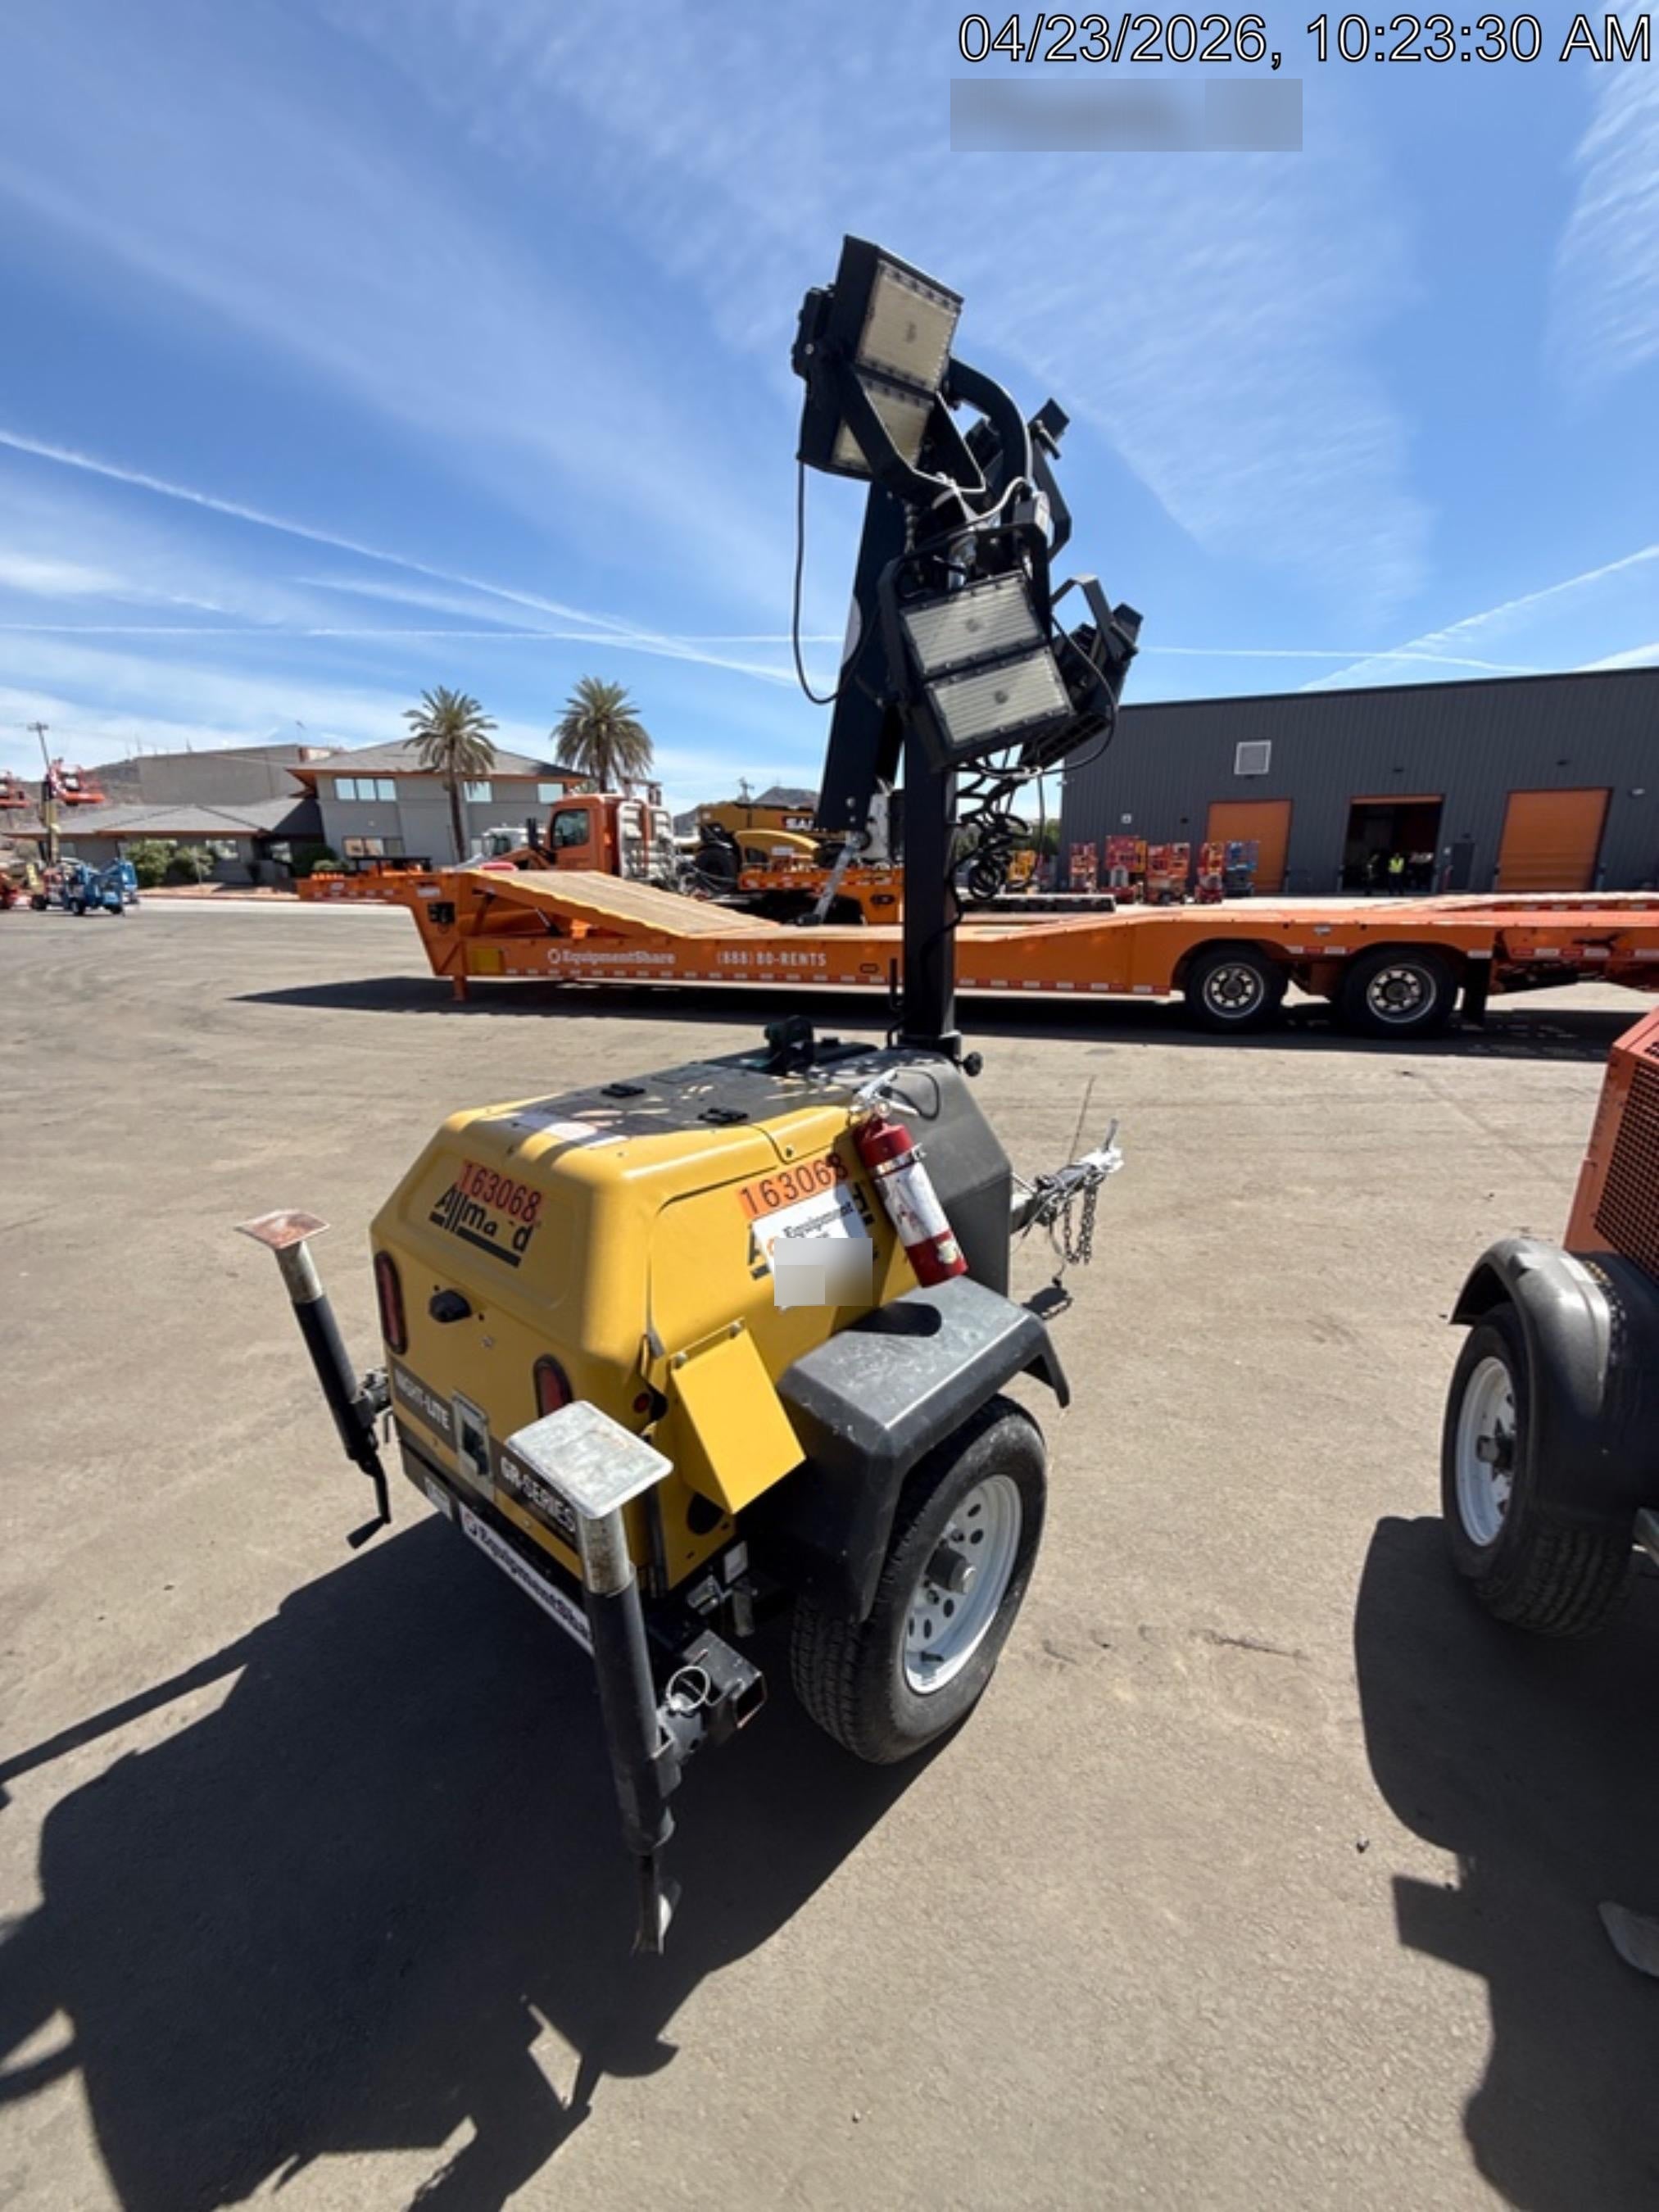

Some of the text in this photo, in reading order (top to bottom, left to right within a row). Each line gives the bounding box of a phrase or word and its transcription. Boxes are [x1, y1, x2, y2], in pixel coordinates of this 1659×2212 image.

[562, 949, 676, 965] EquipmentShare
[460, 1162, 542, 1222] 163068
[741, 1152, 850, 1215] 163068
[434, 1182, 535, 1253] Allmad
